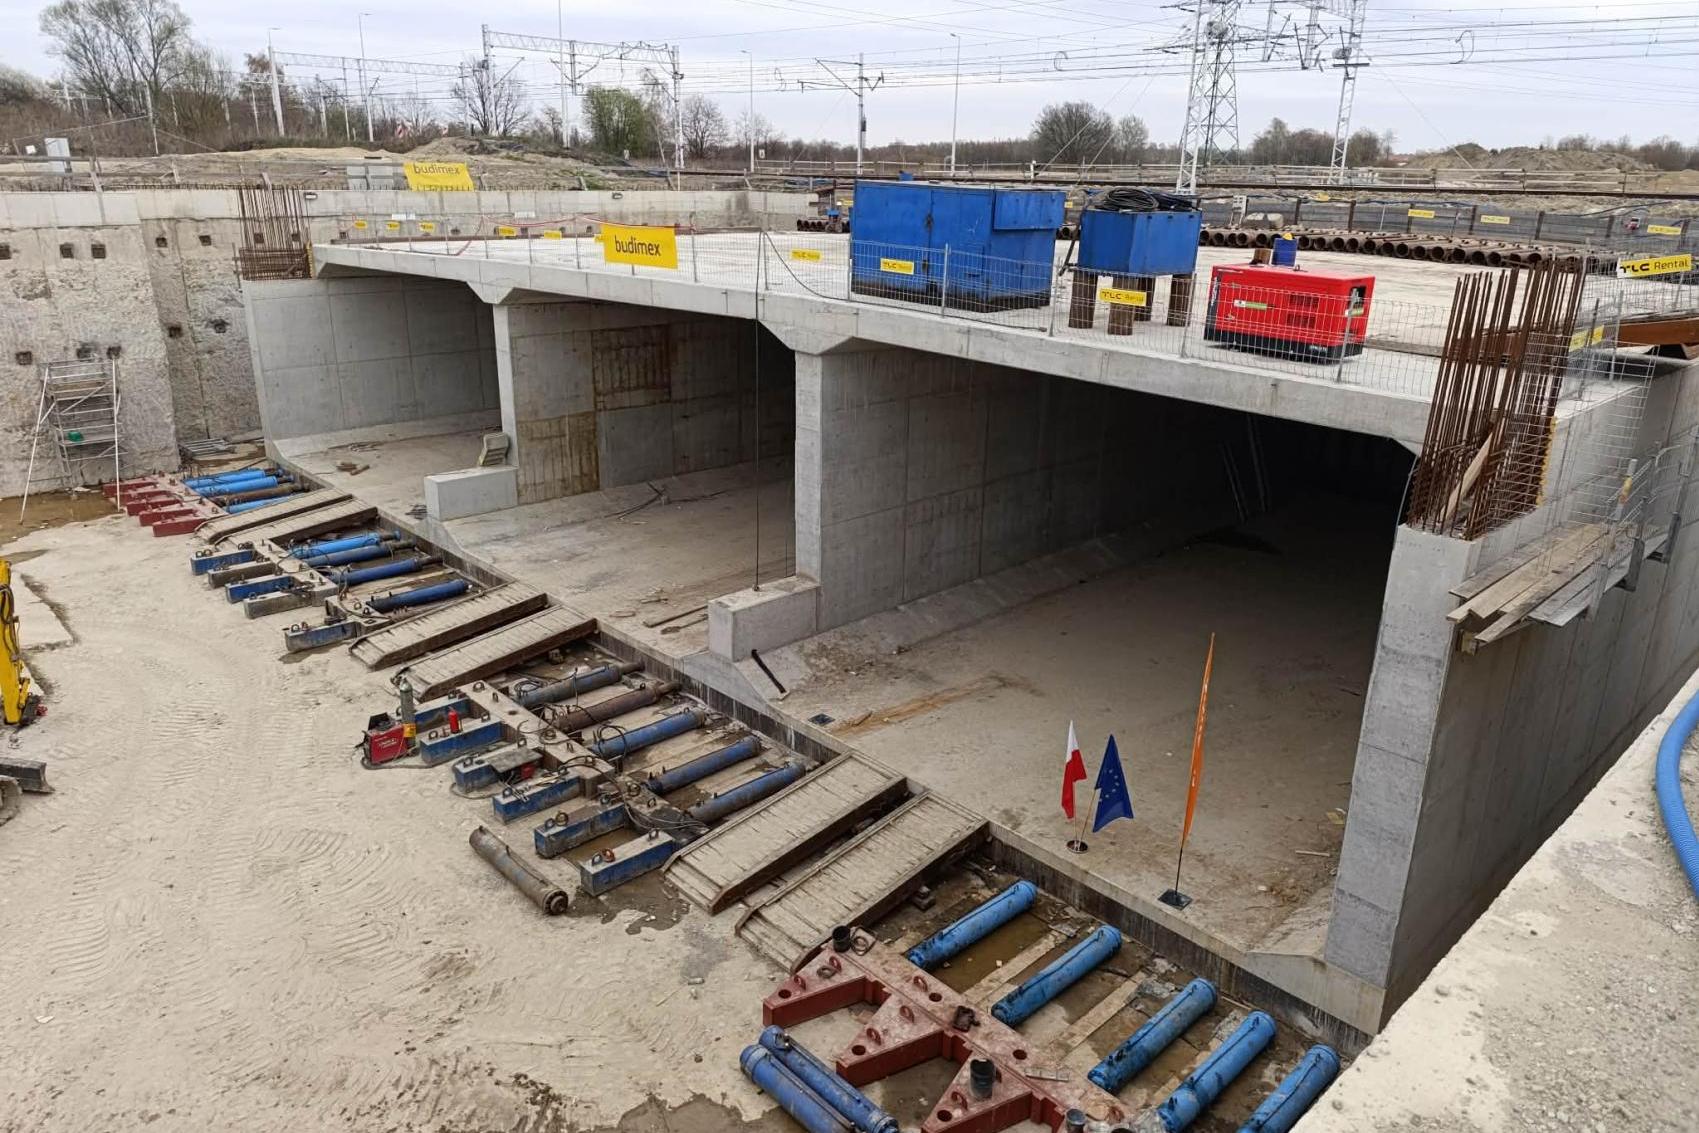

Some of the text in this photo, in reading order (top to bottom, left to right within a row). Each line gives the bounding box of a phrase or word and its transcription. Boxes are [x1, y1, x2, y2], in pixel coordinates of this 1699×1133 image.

[413, 163, 460, 175] budimex
[614, 234, 661, 256] budimex
[1620, 258, 1689, 273] TLC Rental
[1101, 291, 1122, 300] TLC
